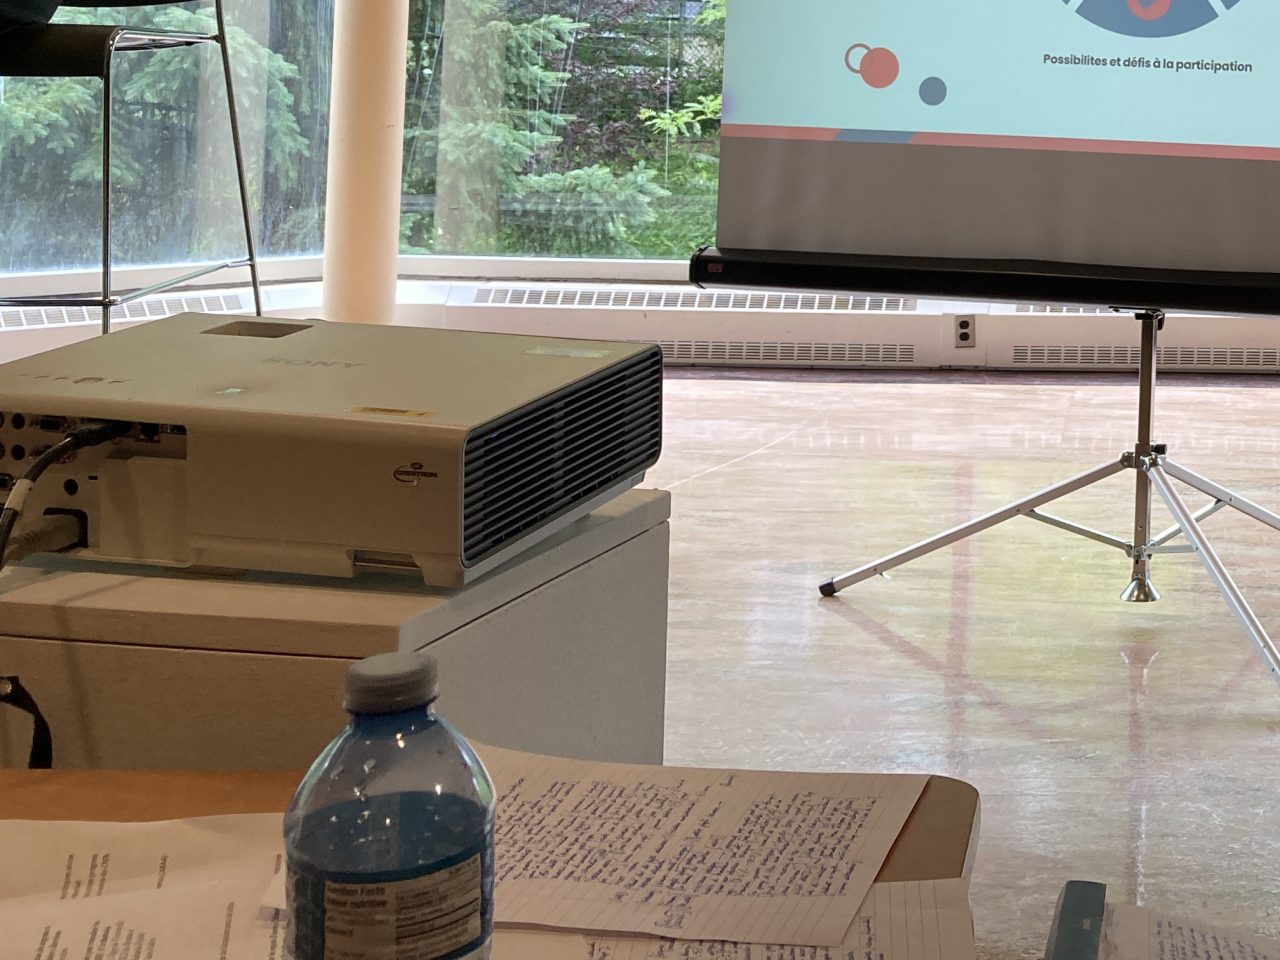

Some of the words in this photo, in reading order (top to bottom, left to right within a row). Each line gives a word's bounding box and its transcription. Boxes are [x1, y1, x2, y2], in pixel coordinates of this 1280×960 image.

[1043, 54, 1107, 66] Possibilites
[1110, 58, 1121, 66] et
[1123, 57, 1150, 68] défis
[1153, 58, 1161, 68] à
[1163, 59, 1174, 69] la
[1176, 60, 1253, 73] participation
